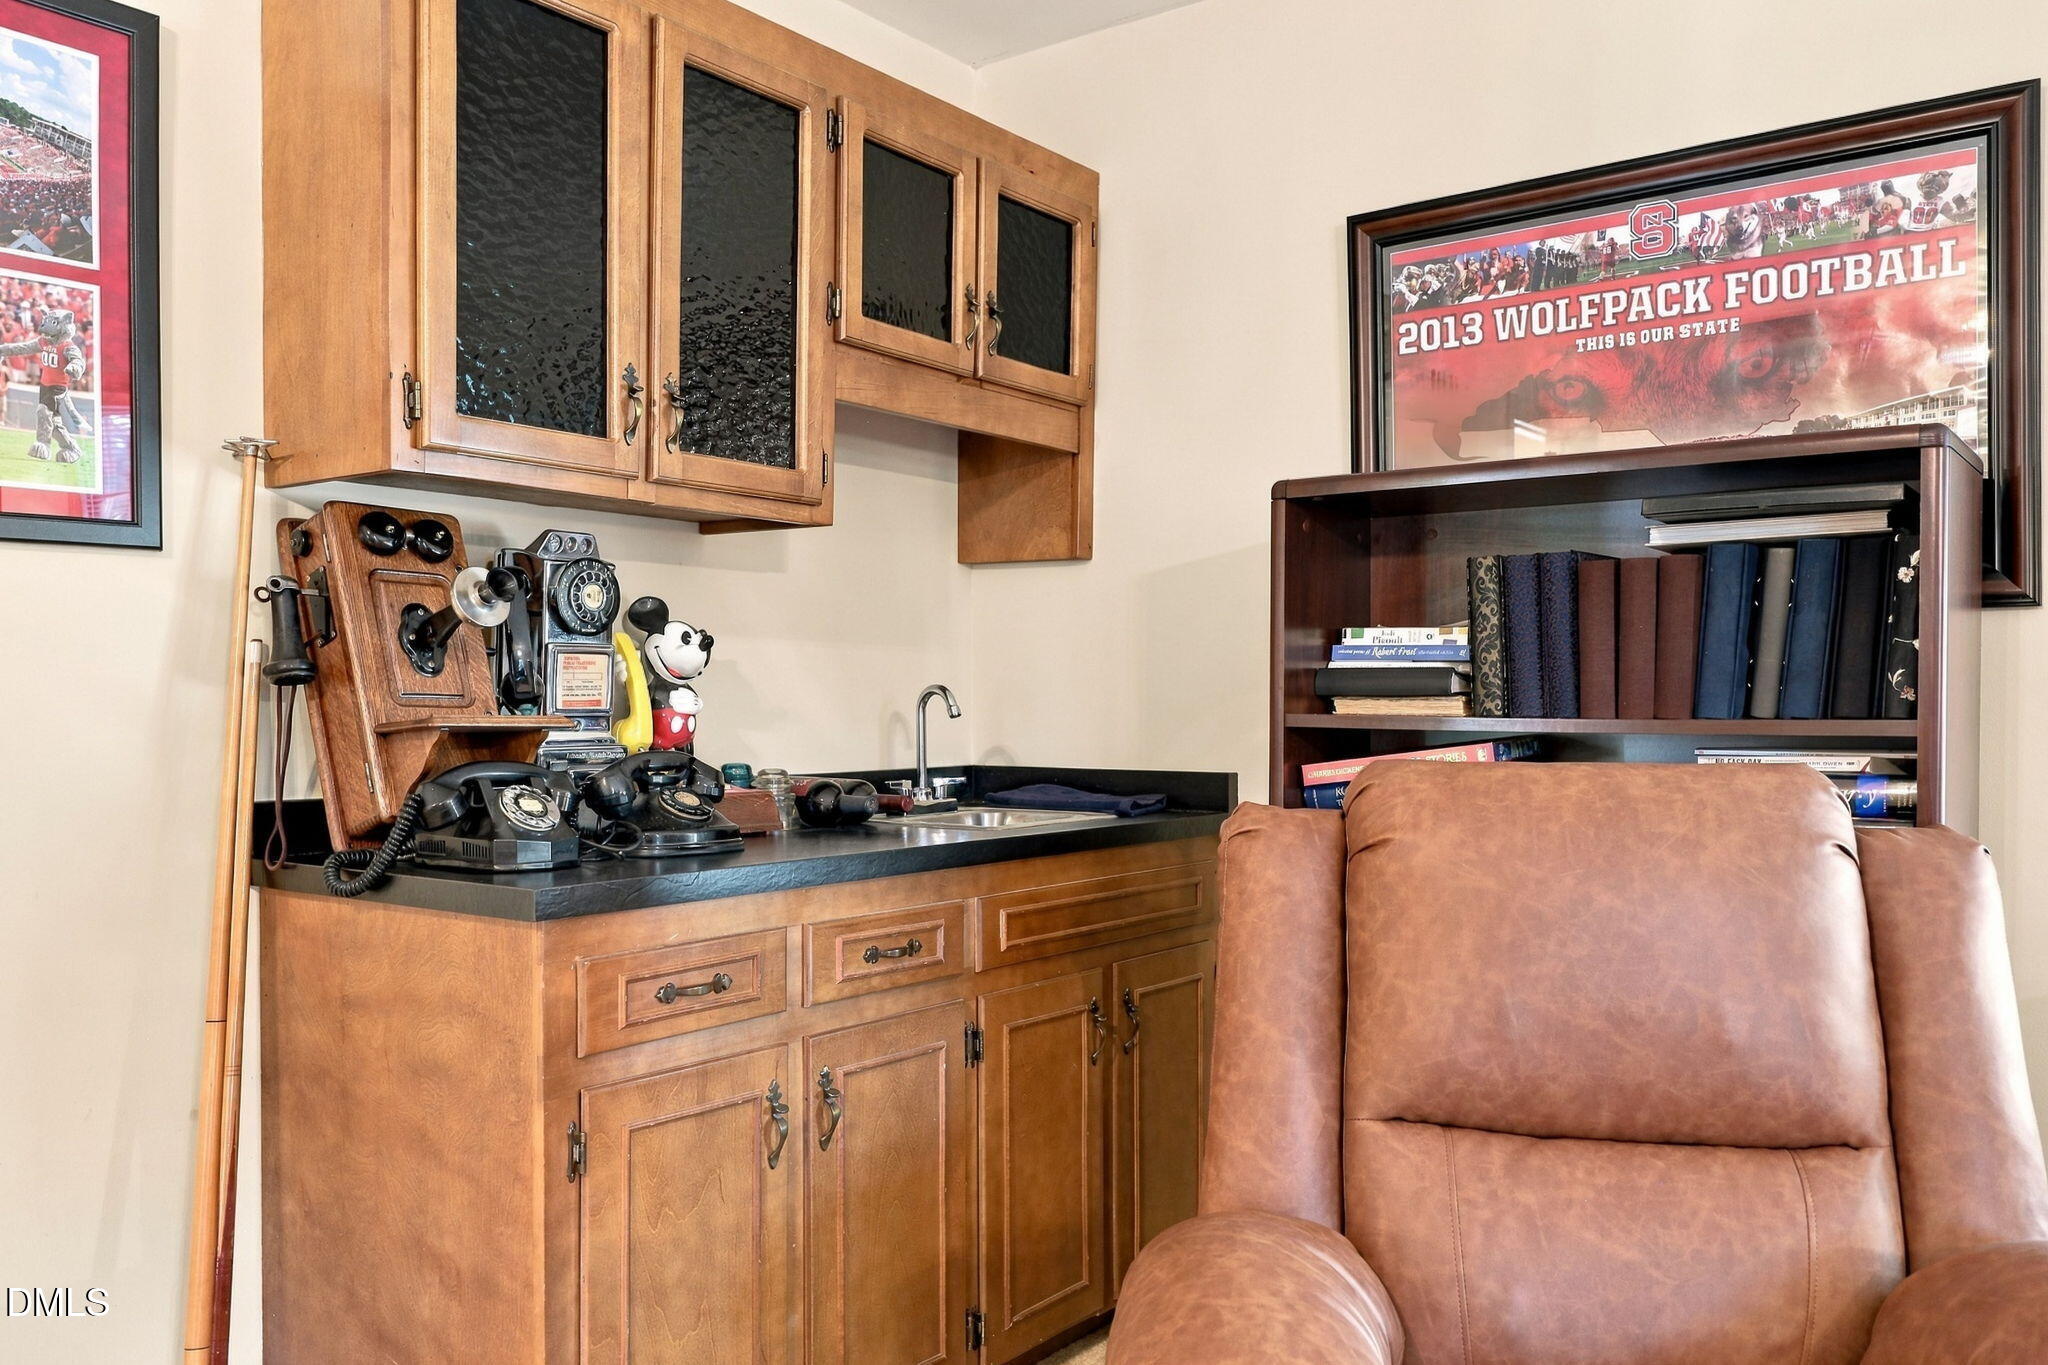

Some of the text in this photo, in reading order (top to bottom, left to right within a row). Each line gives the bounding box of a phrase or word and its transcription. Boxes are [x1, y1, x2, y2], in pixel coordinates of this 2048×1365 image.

[1398, 239, 1967, 355] 2013 WOLFPACK FOOTBALL
[1576, 317, 1741, 352] THIS IS OUR STATE
[1371, 646, 1397, 659] Robert
[1397, 647, 1418, 656] Frost
